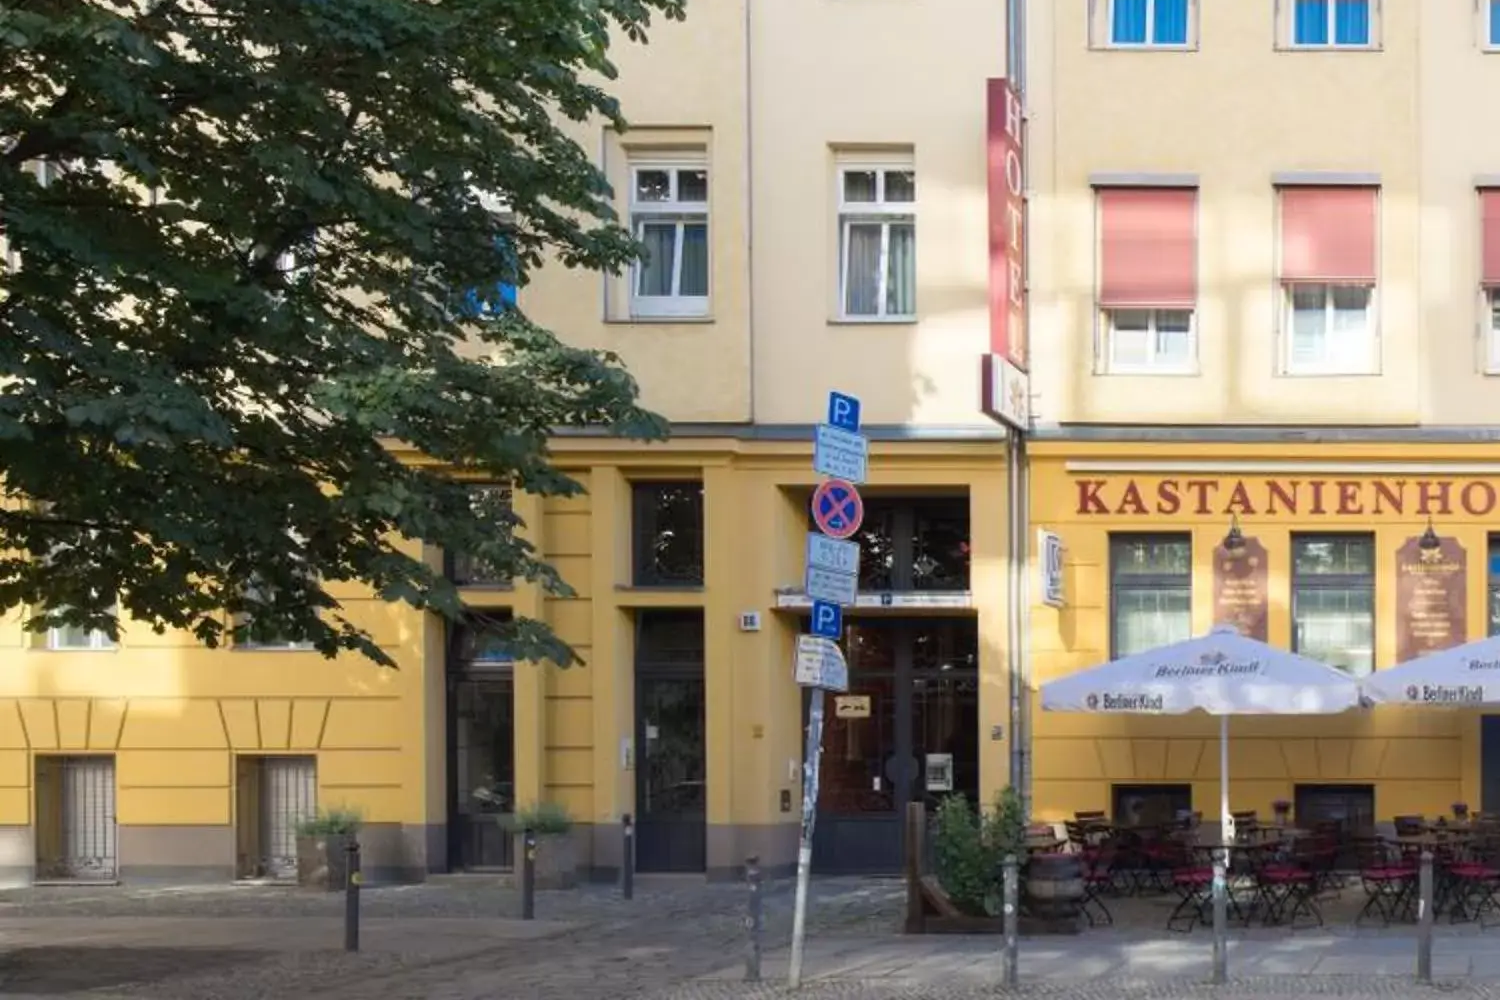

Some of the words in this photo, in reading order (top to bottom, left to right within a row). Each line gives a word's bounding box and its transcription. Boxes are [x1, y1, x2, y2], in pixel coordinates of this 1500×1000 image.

[1005, 89, 1024, 363] HOTEL
[833, 397, 851, 423] P
[818, 605, 835, 632] P
